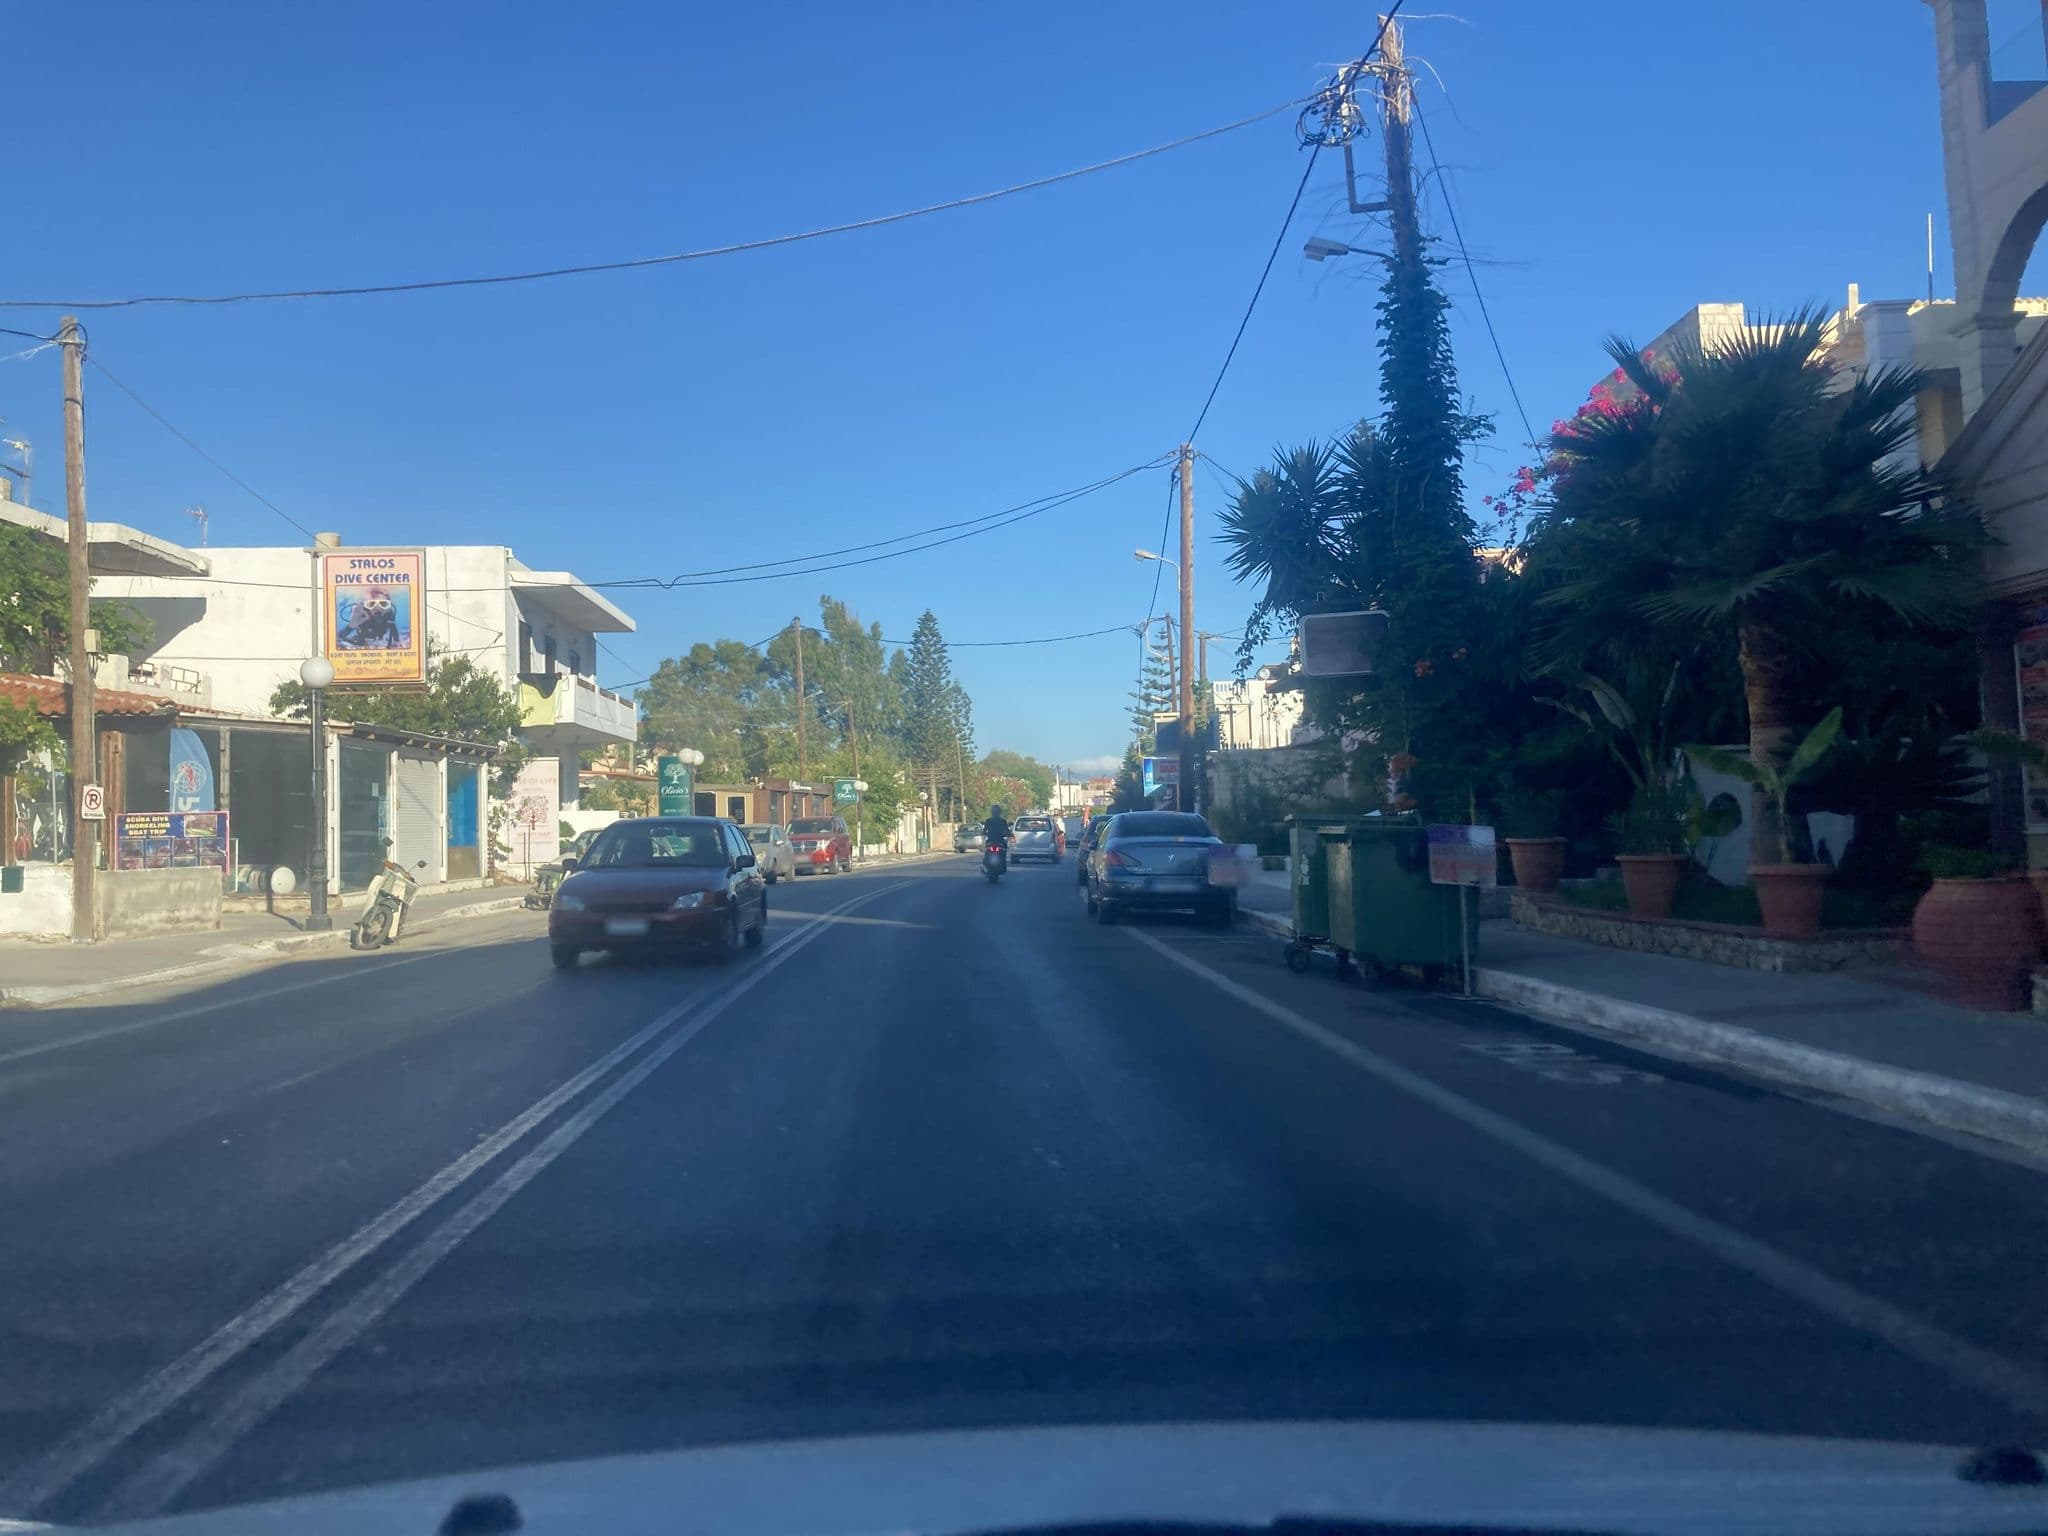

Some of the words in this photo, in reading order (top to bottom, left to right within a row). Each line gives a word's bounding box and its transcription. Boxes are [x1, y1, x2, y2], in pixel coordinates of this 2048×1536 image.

[350, 559, 395, 569] STALOS
[335, 574, 362, 583] DIVE
[366, 573, 410, 583] CENTER
